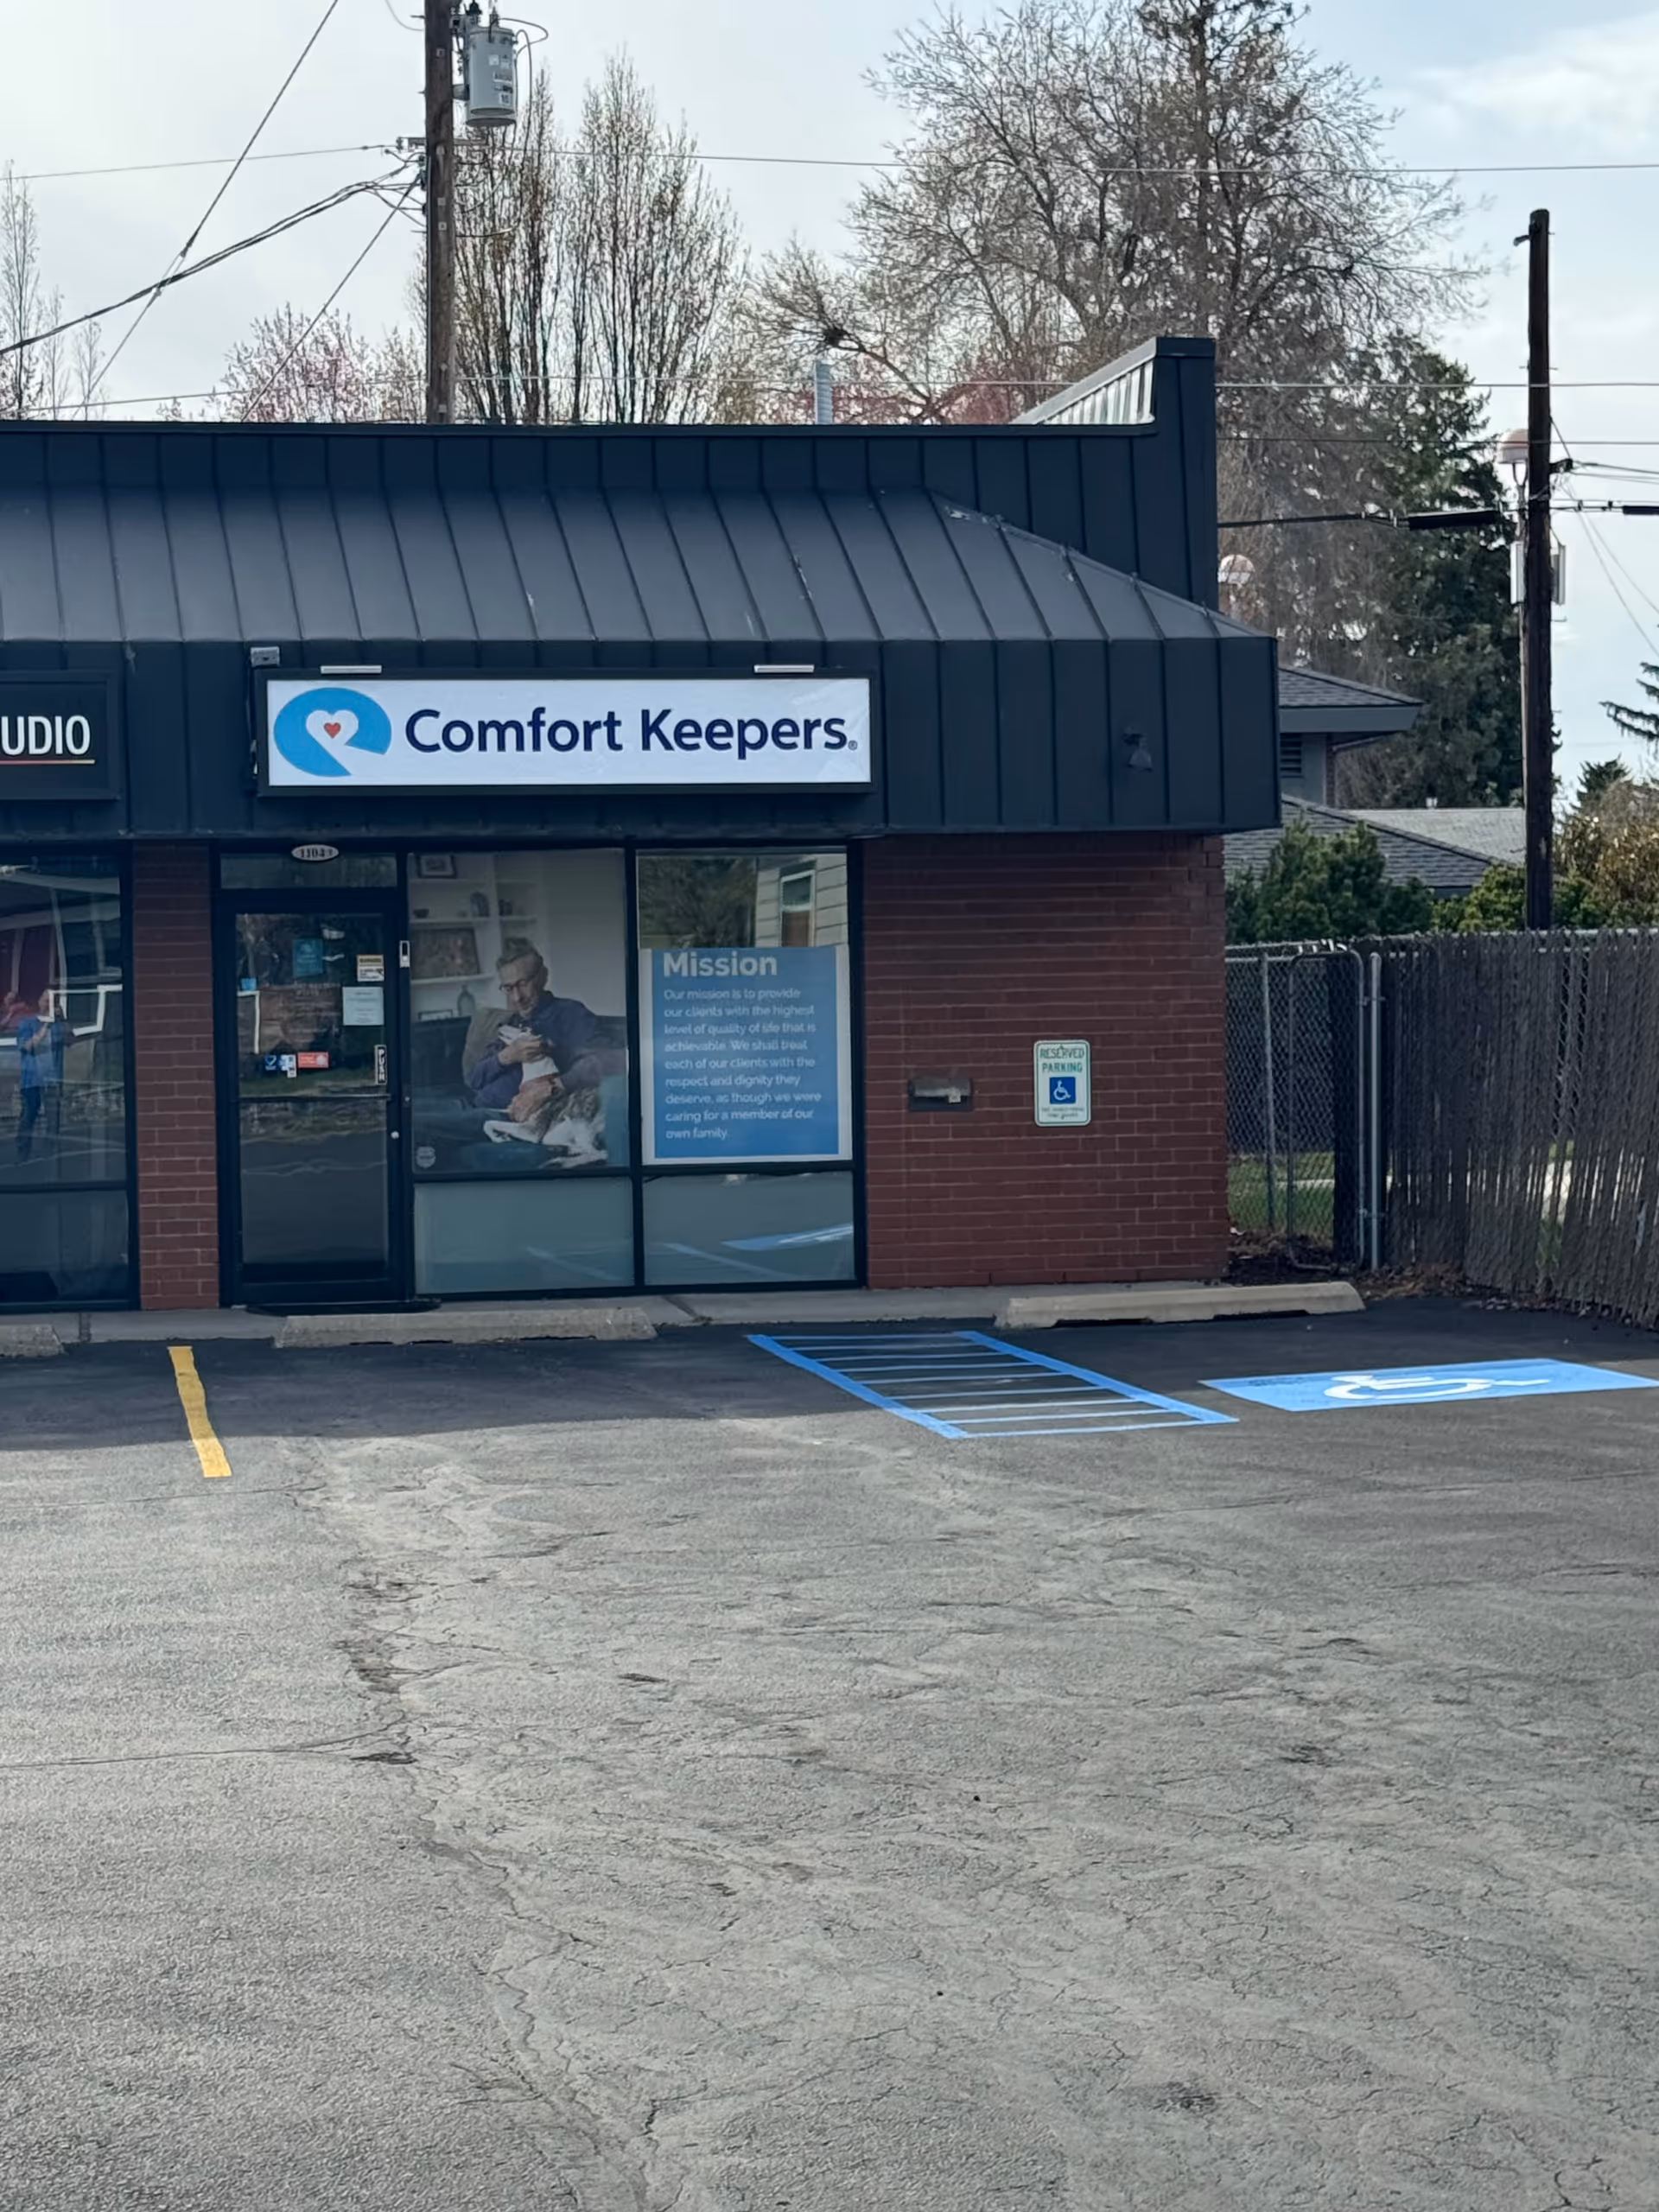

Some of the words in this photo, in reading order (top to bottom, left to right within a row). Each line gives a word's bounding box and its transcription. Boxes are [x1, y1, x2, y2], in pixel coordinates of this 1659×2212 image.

[0, 715, 91, 756] UDIO
[405, 707, 623, 752] Comfort
[663, 950, 778, 977] Mission
[664, 989, 684, 1000] Our
[687, 988, 730, 999] mission
[732, 988, 741, 999] is
[744, 988, 755, 999] to
[758, 988, 801, 1001] provide
[664, 1008, 683, 1017] our
[685, 1006, 722, 1017] clients
[725, 1006, 749, 1016] with
[752, 1005, 772, 1015] the
[772, 1004, 815, 1018] highest
[664, 1024, 691, 1034] level
[694, 1023, 706, 1034] of
[708, 1023, 746, 1036] quality
[748, 1022, 760, 1033] of
[782, 1022, 804, 1033] that
[807, 1022, 817, 1033] is
[730, 1040, 750, 1051] We
[752, 1039, 779, 1051] shall
[781, 1039, 808, 1050] treat
[1039, 1047, 1084, 1059] RESERVED
[664, 1059, 693, 1070] each
[696, 1058, 708, 1069] of
[709, 1060, 728, 1069] our
[730, 1058, 769, 1068] clients
[769, 1058, 794, 1067] with
[797, 1057, 816, 1067] the
[1042, 1062, 1083, 1073] PARKING
[665, 1076, 709, 1089] respect
[710, 1075, 732, 1086] and
[734, 1075, 773, 1089] dignity
[775, 1074, 801, 1087] they
[731, 1093, 772, 1105] though
[774, 1093, 790, 1102] we
[792, 1092, 822, 1102] were
[665, 1111, 702, 1123] caring
[703, 1109, 719, 1121] for
[731, 1109, 779, 1120] member
[782, 1109, 793, 1119] of
[795, 1110, 815, 1119] our
[665, 1129, 690, 1139] own
